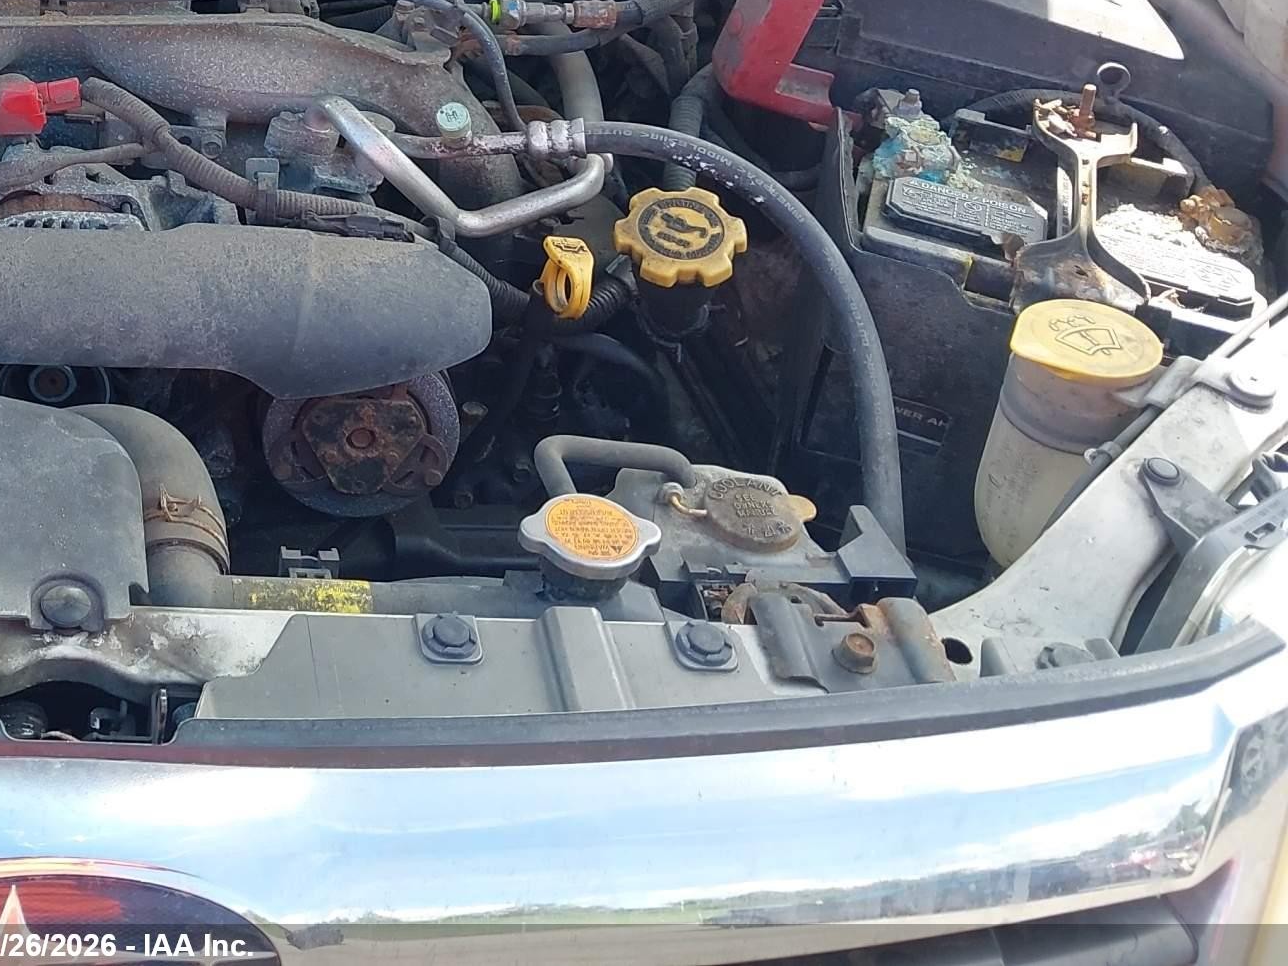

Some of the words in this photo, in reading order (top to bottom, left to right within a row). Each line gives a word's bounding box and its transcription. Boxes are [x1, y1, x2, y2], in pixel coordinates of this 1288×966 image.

[921, 182, 969, 200] DANGER
[982, 197, 1026, 214] POISON
[708, 478, 784, 501] COOLANT
[735, 493, 756, 504] SEE
